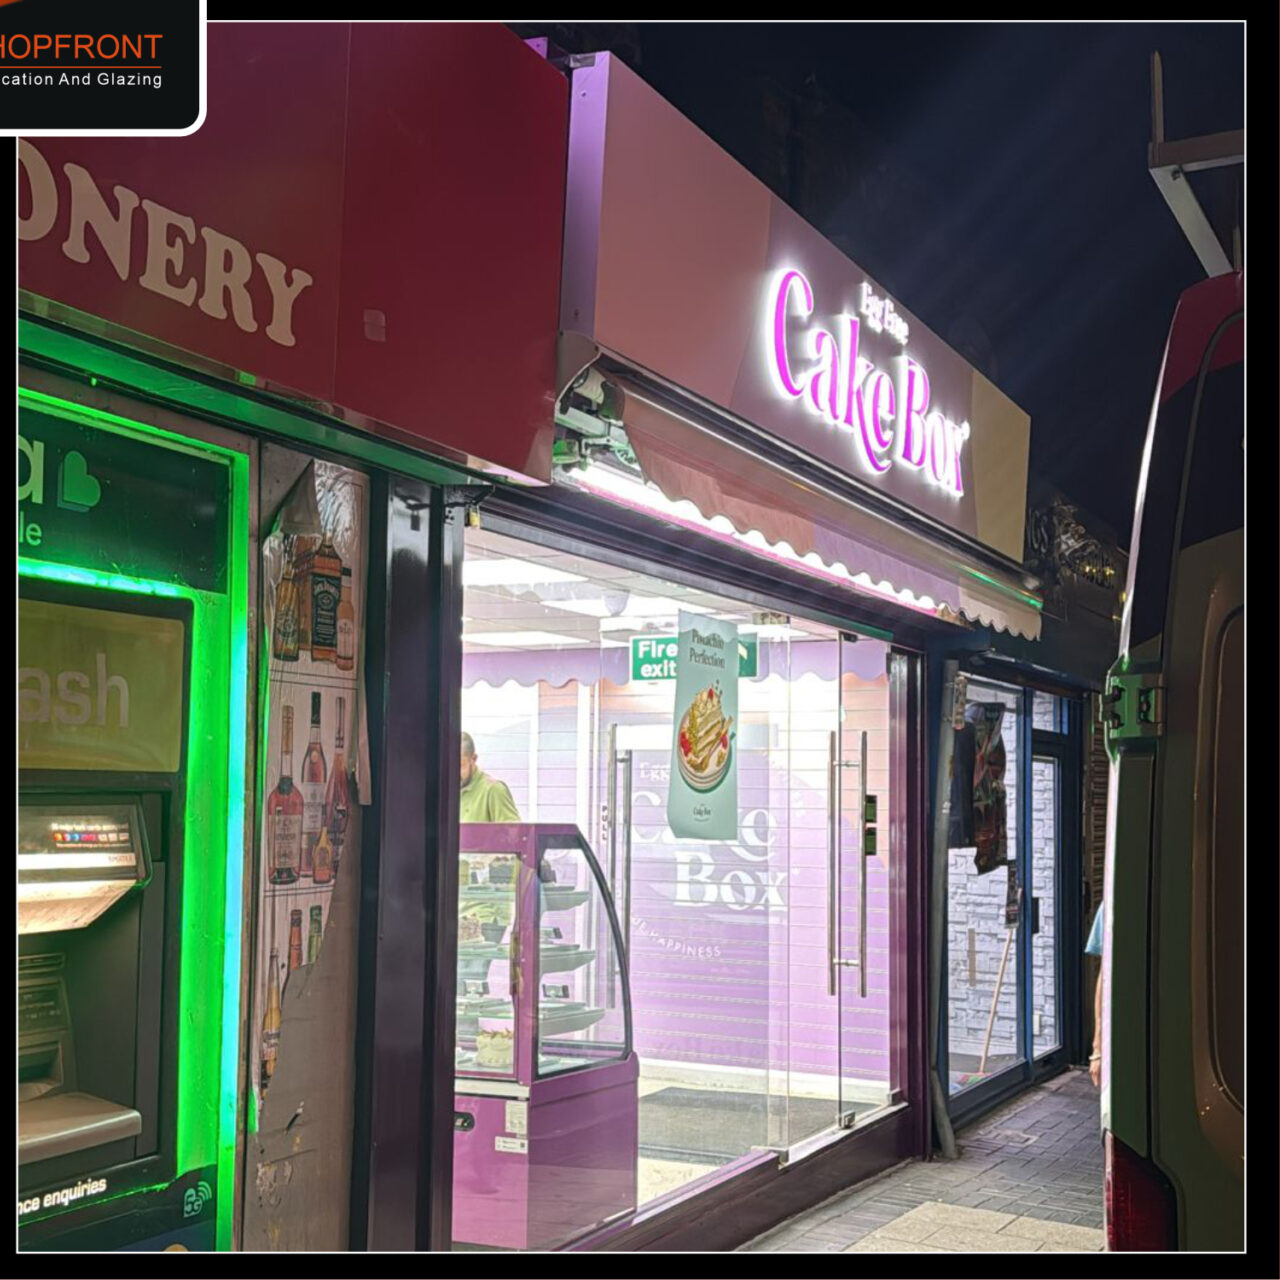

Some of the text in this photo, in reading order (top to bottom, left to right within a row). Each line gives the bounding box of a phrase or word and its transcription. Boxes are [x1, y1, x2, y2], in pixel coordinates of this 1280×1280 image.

[767, 268, 965, 499] Cake Box
[638, 640, 679, 659] Fire
[640, 659, 677, 677] exit
[673, 850, 789, 912] Box
[43, 1178, 108, 1207] enquiries
